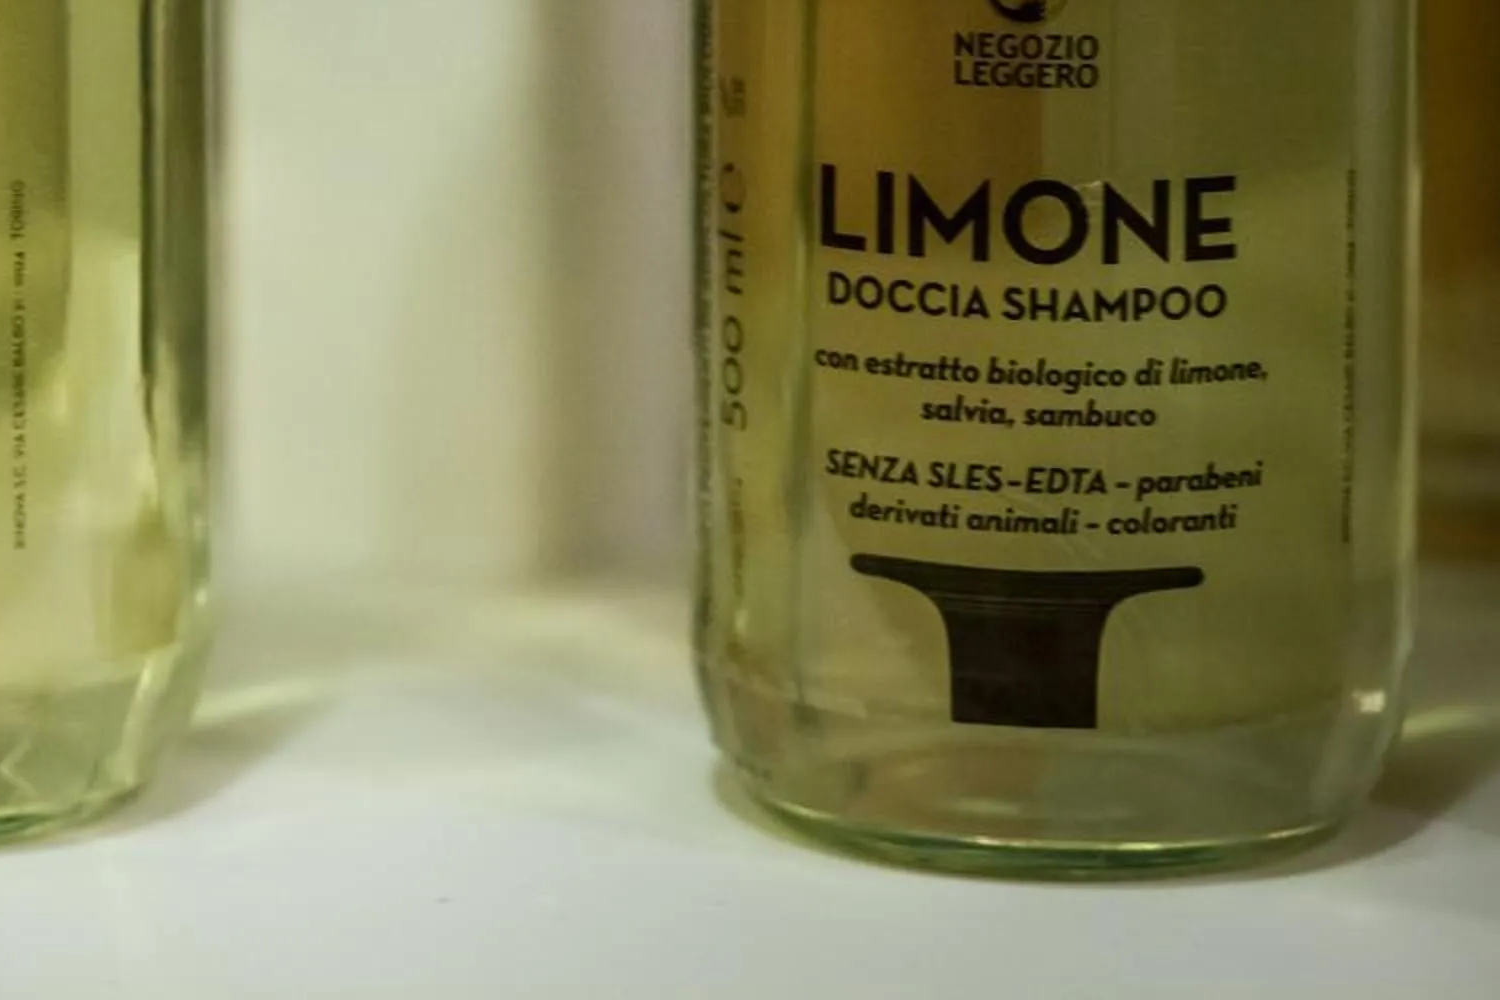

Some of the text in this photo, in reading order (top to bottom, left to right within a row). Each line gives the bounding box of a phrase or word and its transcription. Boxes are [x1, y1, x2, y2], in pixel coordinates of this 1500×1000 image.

[955, 32, 1098, 61] NEGOZIO
[955, 61, 1098, 89] LEGGERO
[820, 164, 1237, 265] LIMONE
[829, 272, 1227, 322] DOCCIA SHAMPOO
[719, 230, 747, 431] 500 ml
[815, 349, 1268, 394] con estratto biologico di limone,
[921, 394, 1156, 428] salvia, sambuco
[826, 449, 918, 485] SENZA
[1135, 460, 1264, 501] parabeni
[850, 492, 961, 529] derivati
[967, 507, 1080, 534] animali
[1107, 504, 1238, 535] coloranti
